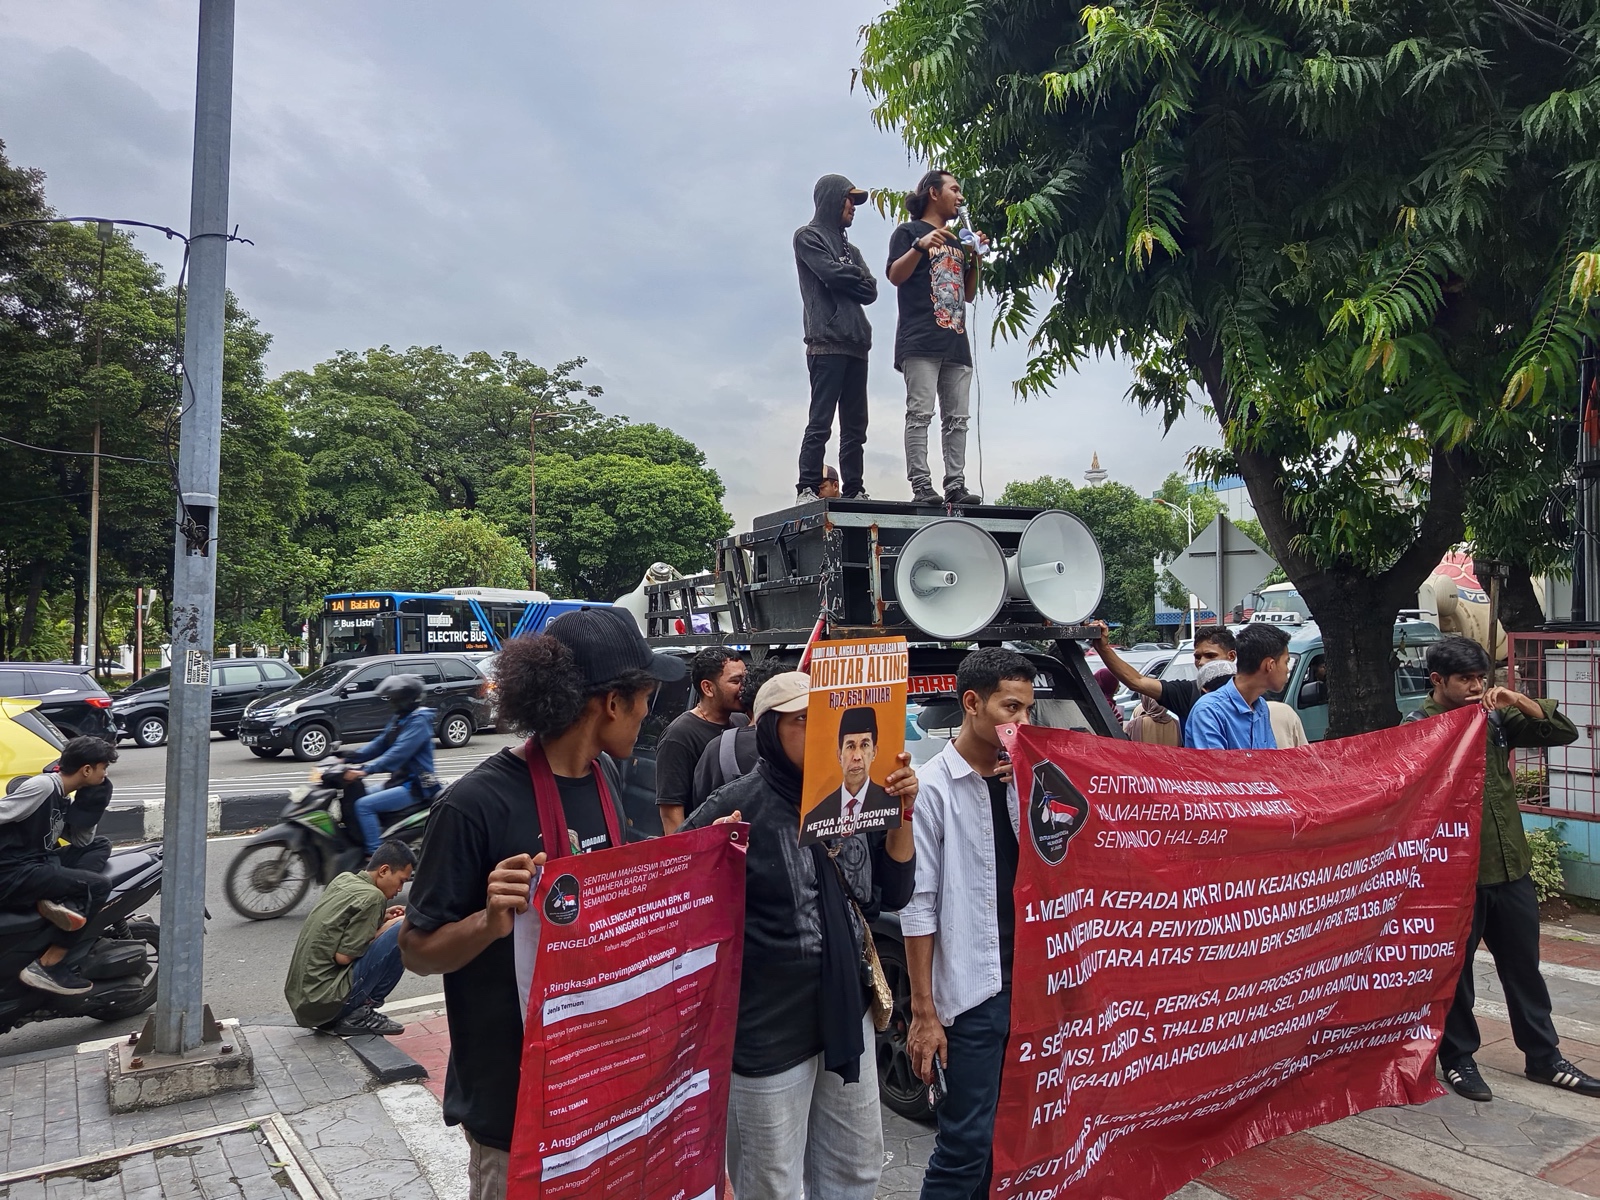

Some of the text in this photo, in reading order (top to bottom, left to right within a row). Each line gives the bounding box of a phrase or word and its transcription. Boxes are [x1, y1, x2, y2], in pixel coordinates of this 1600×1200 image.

[350, 600, 368, 610] Balai
[341, 619, 355, 628] Bus
[1254, 614, 1295, 622] M-04
[428, 630, 487, 643] ELECTRIC BUS
[194, 652, 202, 666] WC
[810, 654, 907, 688] MOHTAR ALTING
[864, 686, 892, 704] MILIAR
[1088, 775, 1284, 796] SENTRUM MAHASISWA INDONESIA
[806, 807, 900, 832] KETUA KPU PROVINSI
[1184, 800, 1296, 821] BARAT DKI-JAKARTA
[816, 818, 885, 838] MALUKU UTARA
[1164, 828, 1228, 846] HAL-BAR
[582, 862, 689, 898] HALMAHERA BARAT DKI JAKARTA
[584, 854, 692, 887] SENTRUM MAHASISWA INDONESIA
[583, 884, 648, 909] SEMAINDO HAL-BAR
[1025, 902, 1040, 922] 1.
[1100, 890, 1178, 910] KEPADA
[1182, 886, 1208, 908] KPK
[1208, 883, 1222, 904] RI
[1224, 878, 1255, 900] DAN
[1258, 866, 1333, 896] KEJAKSAAN
[1333, 856, 1368, 884] AGUNG
[589, 890, 690, 934] DATA LENGKAP TEMUAN BPK RI
[1046, 932, 1074, 960] DAN
[1148, 912, 1241, 938] PENYIDIKAN
[1243, 902, 1297, 930] DUGAAN
[1298, 884, 1358, 916] KEJAHATAN
[1422, 847, 1448, 864] KPU
[546, 894, 714, 952] PENGELOLAAN ANGGARAN KPU MALUKU UTARA
[604, 942, 620, 952] Tahun
[648, 926, 666, 936] Semester
[1148, 946, 1194, 967] ATAS
[1196, 937, 1259, 962] TEMUAN
[1260, 930, 1285, 955] BPK
[1284, 918, 1324, 947] SENILAI
[549, 946, 677, 994] Ringkasan Penyimpangan Keuangan
[1019, 1042, 1036, 1063] 2.
[1098, 1000, 1150, 1035] PANGGIL,
[1154, 990, 1221, 1016] PERIKSA,
[1224, 982, 1257, 1002] DAN
[1256, 966, 1303, 996] PROSES
[1302, 953, 1343, 980] HUKUM
[1402, 918, 1435, 935] KPU
[1141, 1026, 1157, 1044] S.
[1161, 1017, 1214, 1041] THALIB
[1215, 1008, 1246, 1030] KPU
[1246, 994, 1295, 1023] HAL-SEL,
[1298, 984, 1324, 1006] DAN
[1376, 945, 1406, 962] KPU
[1410, 941, 1456, 958] TIDORE,
[547, 1000, 584, 1016] Jenis Temuan
[546, 1030, 566, 1040] Belanja
[566, 1024, 582, 1034] Tanpa
[1122, 1033, 1246, 1086] PENYALAHGUNAAN
[1248, 1013, 1316, 1046] ANGGARAN
[1372, 968, 1434, 990] 2023-2024
[550, 1043, 600, 1066] Pertanggungjawaban
[614, 1034, 631, 1044] sesuai
[548, 1076, 579, 1092] Pengadaan
[578, 1072, 590, 1082] Jasa
[590, 1068, 600, 1077] KAP
[1108, 1122, 1142, 1144] DAN
[1366, 1030, 1402, 1048] MANA
[1402, 1024, 1438, 1040] PUN.
[549, 1098, 588, 1117] TOTAL TEMUAN
[538, 1142, 548, 1152] 2.
[550, 1126, 594, 1151] Anggaran
[594, 1120, 609, 1134] dan
[609, 1104, 644, 1125] Realisasi
[1014, 1157, 1064, 1186] USUT
[545, 1184, 564, 1195] Tahun
